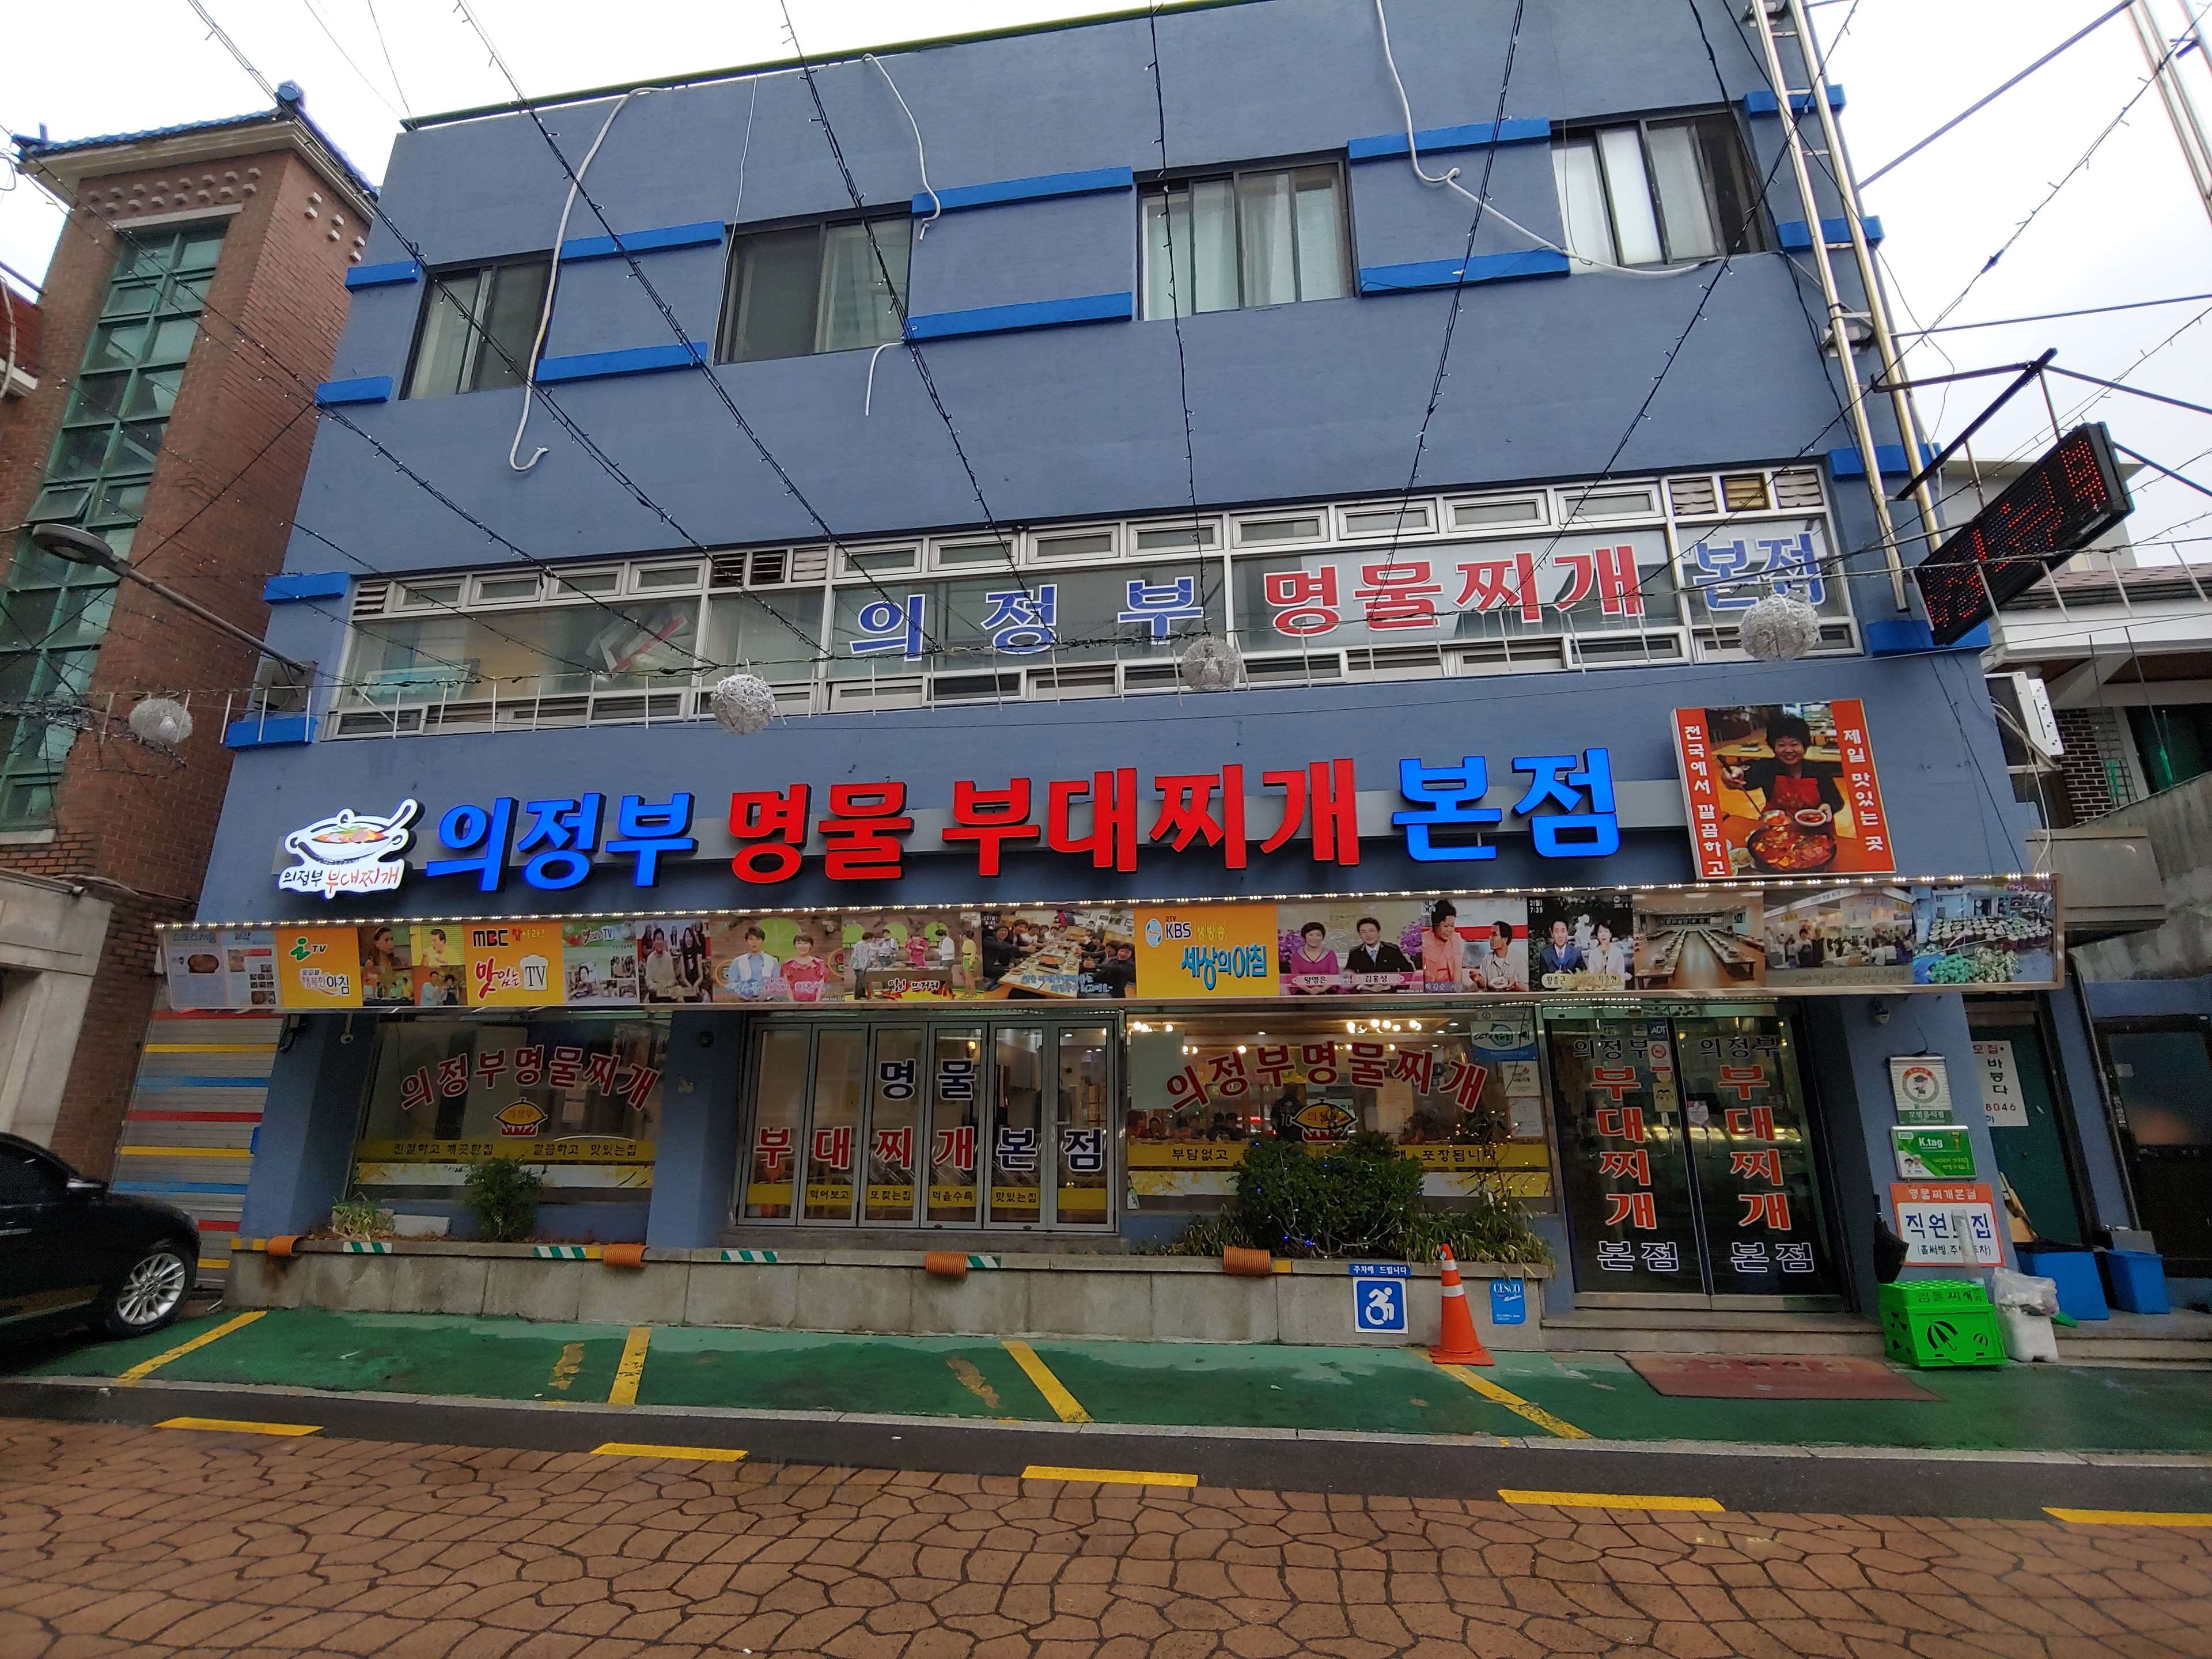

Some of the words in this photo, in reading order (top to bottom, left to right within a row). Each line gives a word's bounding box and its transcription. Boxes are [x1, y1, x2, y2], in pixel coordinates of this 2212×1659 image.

[849, 576, 1204, 662] 의정부
[1263, 543, 1646, 638] 명물찌개
[1684, 725, 1711, 795] 전국에서
[1843, 729, 1866, 763] 제일
[1851, 772, 1879, 826] 맛있는
[426, 793, 698, 892] 의정부
[730, 782, 915, 884] 명물
[942, 757, 1360, 878] 부대찌개
[1392, 748, 1620, 863] 본점
[1697, 804, 1725, 875] 깔끔하고
[1865, 836, 1884, 851] 곳
[282, 869, 323, 887] 의정부
[325, 866, 400, 894] 부대찌개
[472, 930, 509, 947] MBC
[1165, 922, 1192, 939] KBS
[1196, 925, 1227, 941] 생방송
[525, 965, 546, 987] TV
[1651, 1025, 1666, 1034] ADT
[1573, 1039, 1649, 1060] 의정부
[1700, 1037, 1778, 1058] 의정부
[879, 1058, 977, 1101] 명물
[533, 1143, 579, 1156] 깔끔하고
[755, 1126, 975, 1171] 부대찌개
[995, 1127, 1103, 1172] 본점
[1172, 1148, 1229, 1161] 부담없고
[1590, 1066, 1658, 1229] 부대찌개
[1717, 1065, 1792, 1231] 부대찌개
[1918, 1137, 1944, 1149] K.tag
[1596, 1240, 1679, 1272] 본점
[1730, 1242, 1815, 1274] 본점
